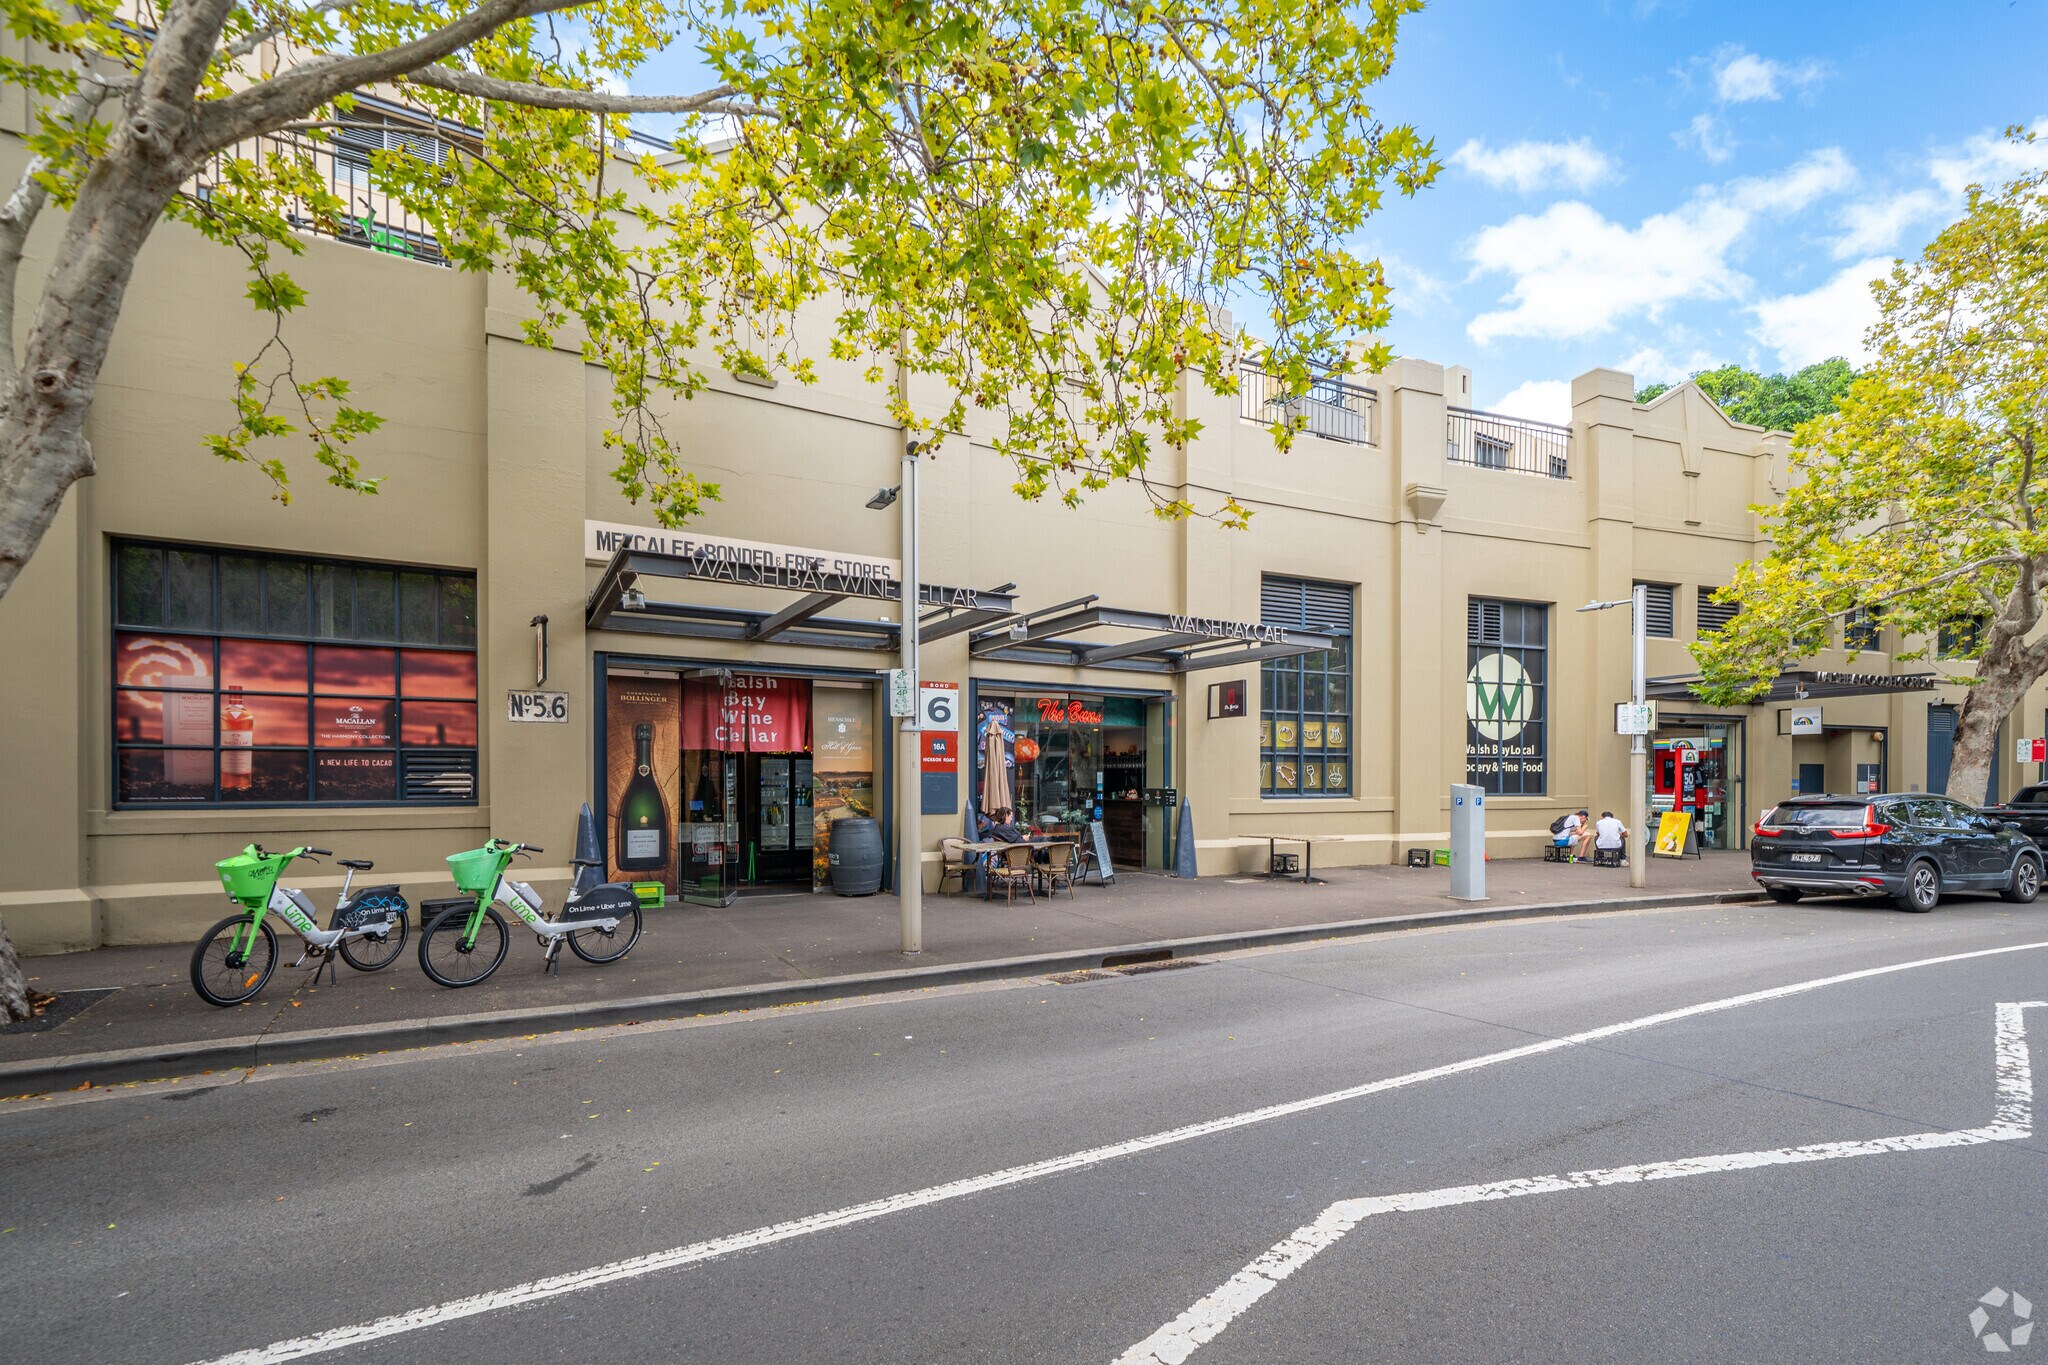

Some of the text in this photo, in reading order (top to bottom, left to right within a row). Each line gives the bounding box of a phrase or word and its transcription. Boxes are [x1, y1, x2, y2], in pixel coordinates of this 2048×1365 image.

[834, 560, 891, 580] STORES
[692, 556, 978, 607] WALSH BAY WINE ELLAR
[1170, 614, 1288, 643] WALSH BAY CAFE
[620, 695, 667, 703] BOLLINGER
[1473, 676, 1526, 726] W
[722, 708, 773, 725] Wine
[927, 696, 951, 723] 6
[1038, 698, 1065, 723] The
[715, 726, 778, 743] Cellar
[933, 743, 945, 751] 16A
[1492, 745, 1510, 757] Bay
[1510, 745, 1535, 755] Local
[327, 759, 341, 767] NEW
[1492, 762, 1499, 772] &
[1522, 762, 1543, 772] Food
[371, 907, 385, 915] Lime
[580, 905, 595, 913] Lime
[601, 903, 616, 911] Uber
